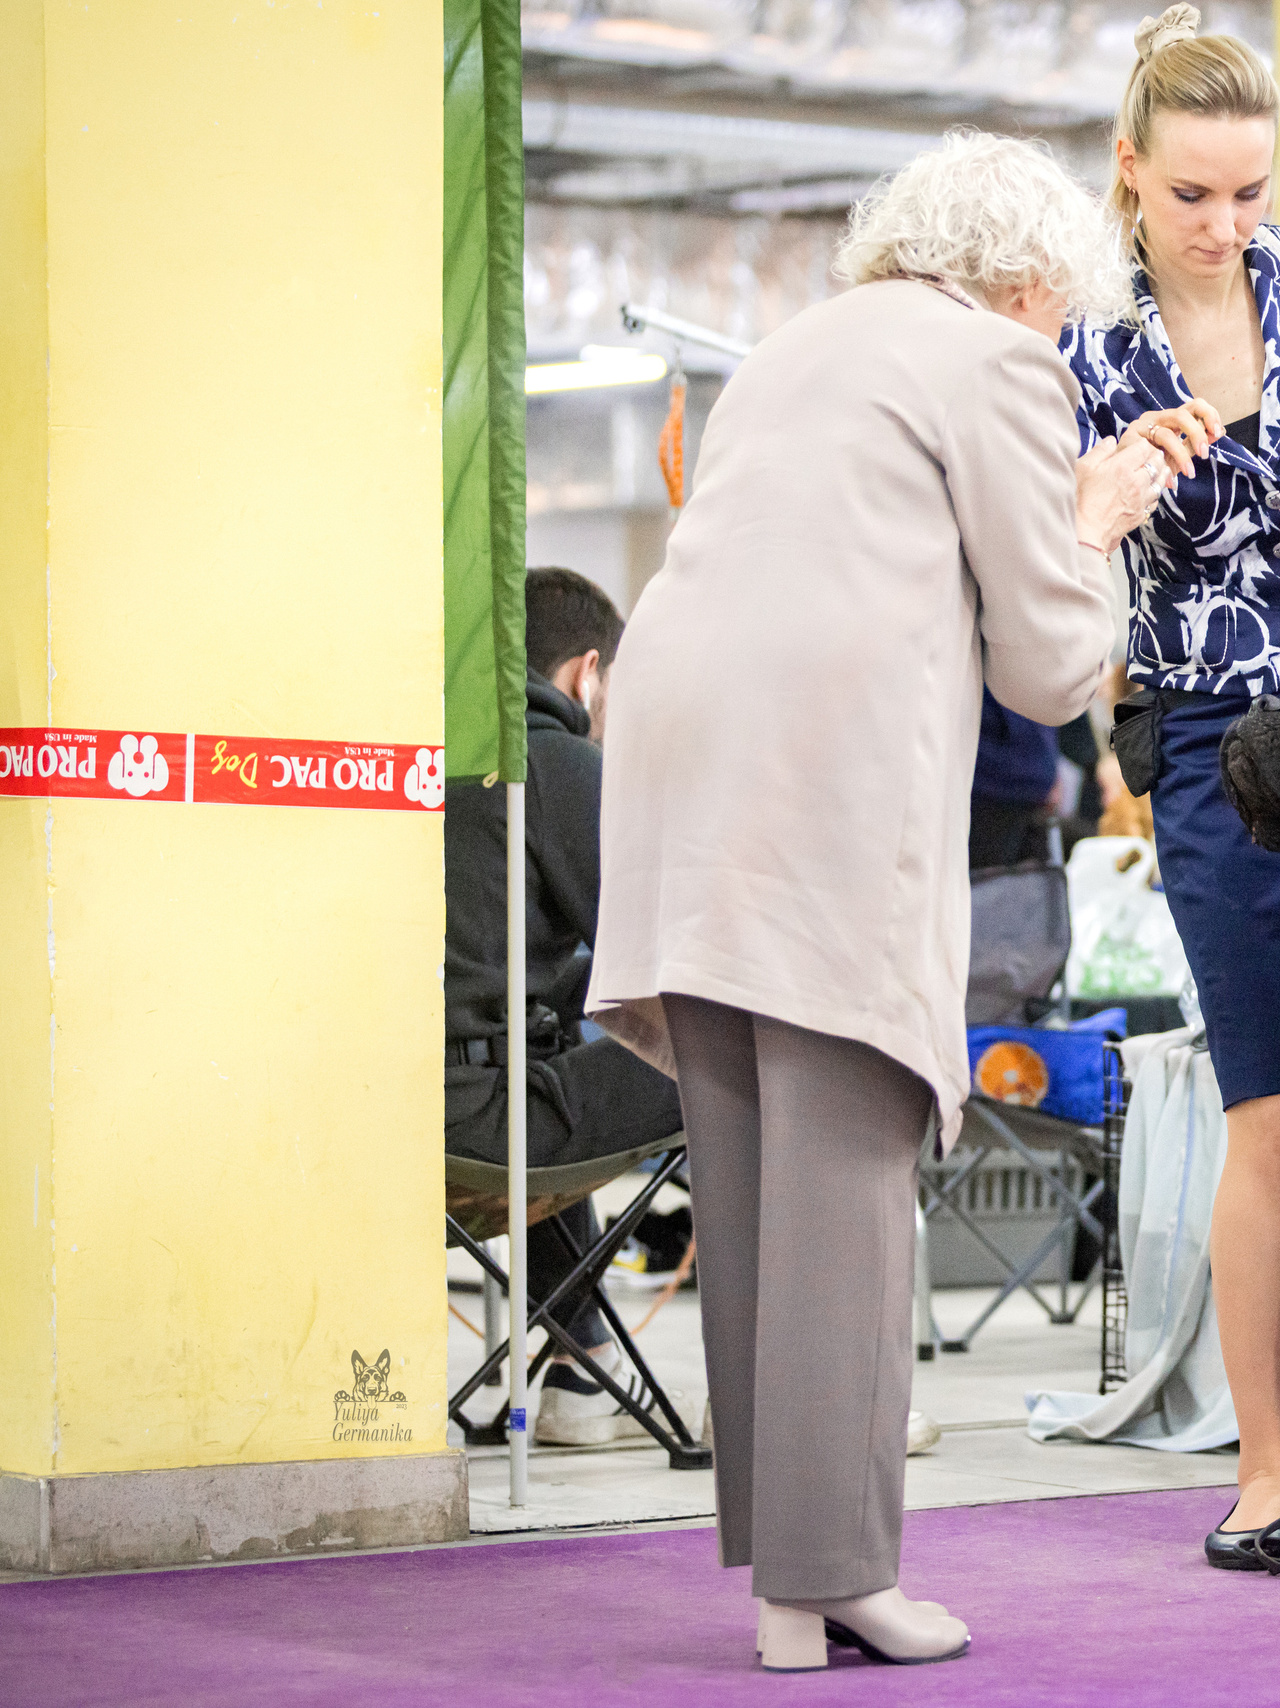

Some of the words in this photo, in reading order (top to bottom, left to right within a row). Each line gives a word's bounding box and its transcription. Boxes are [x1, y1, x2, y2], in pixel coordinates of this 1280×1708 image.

[44, 732, 61, 742] USA
[62, 733, 72, 743] in
[74, 733, 98, 744] Made
[344, 746, 361, 756] USA
[362, 747, 372, 757] in
[373, 747, 395, 757] Made
[0, 744, 34, 778] PAC
[37, 744, 97, 779] PRO
[210, 740, 258, 789] Dog
[270, 754, 327, 788] PAC
[332, 757, 395, 792] PRO
